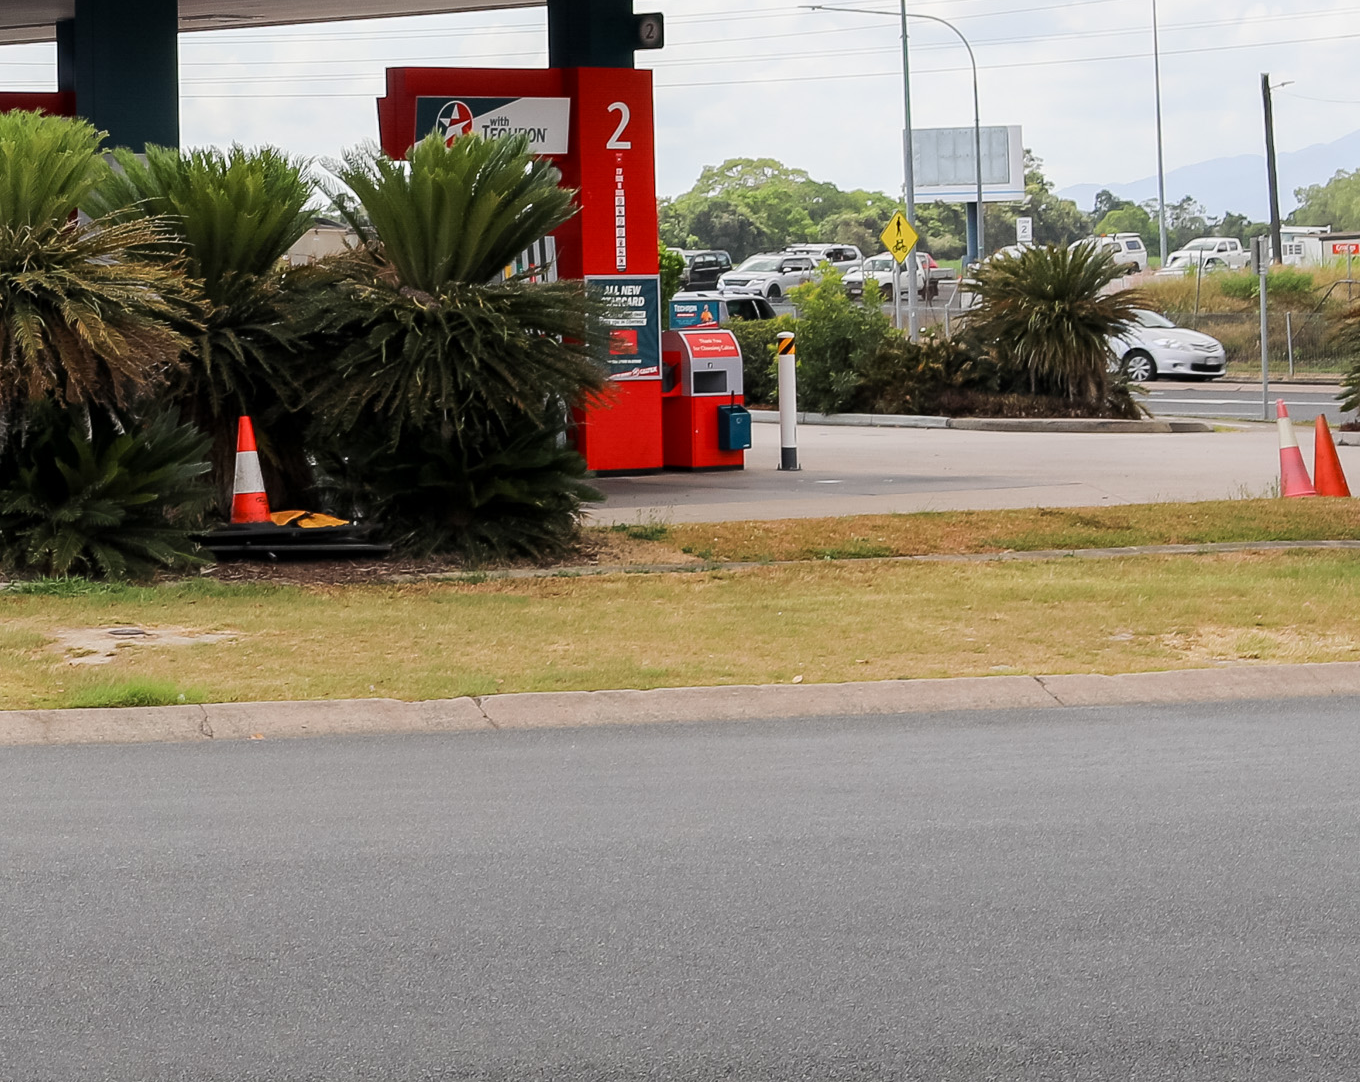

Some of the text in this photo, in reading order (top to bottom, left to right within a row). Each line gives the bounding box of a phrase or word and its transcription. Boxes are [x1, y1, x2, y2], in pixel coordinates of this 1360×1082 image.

[645, 22, 655, 40] 2
[490, 116, 510, 127] with
[605, 101, 632, 150] 2
[1021, 225, 1028, 234] 2
[620, 285, 642, 295] NEW
